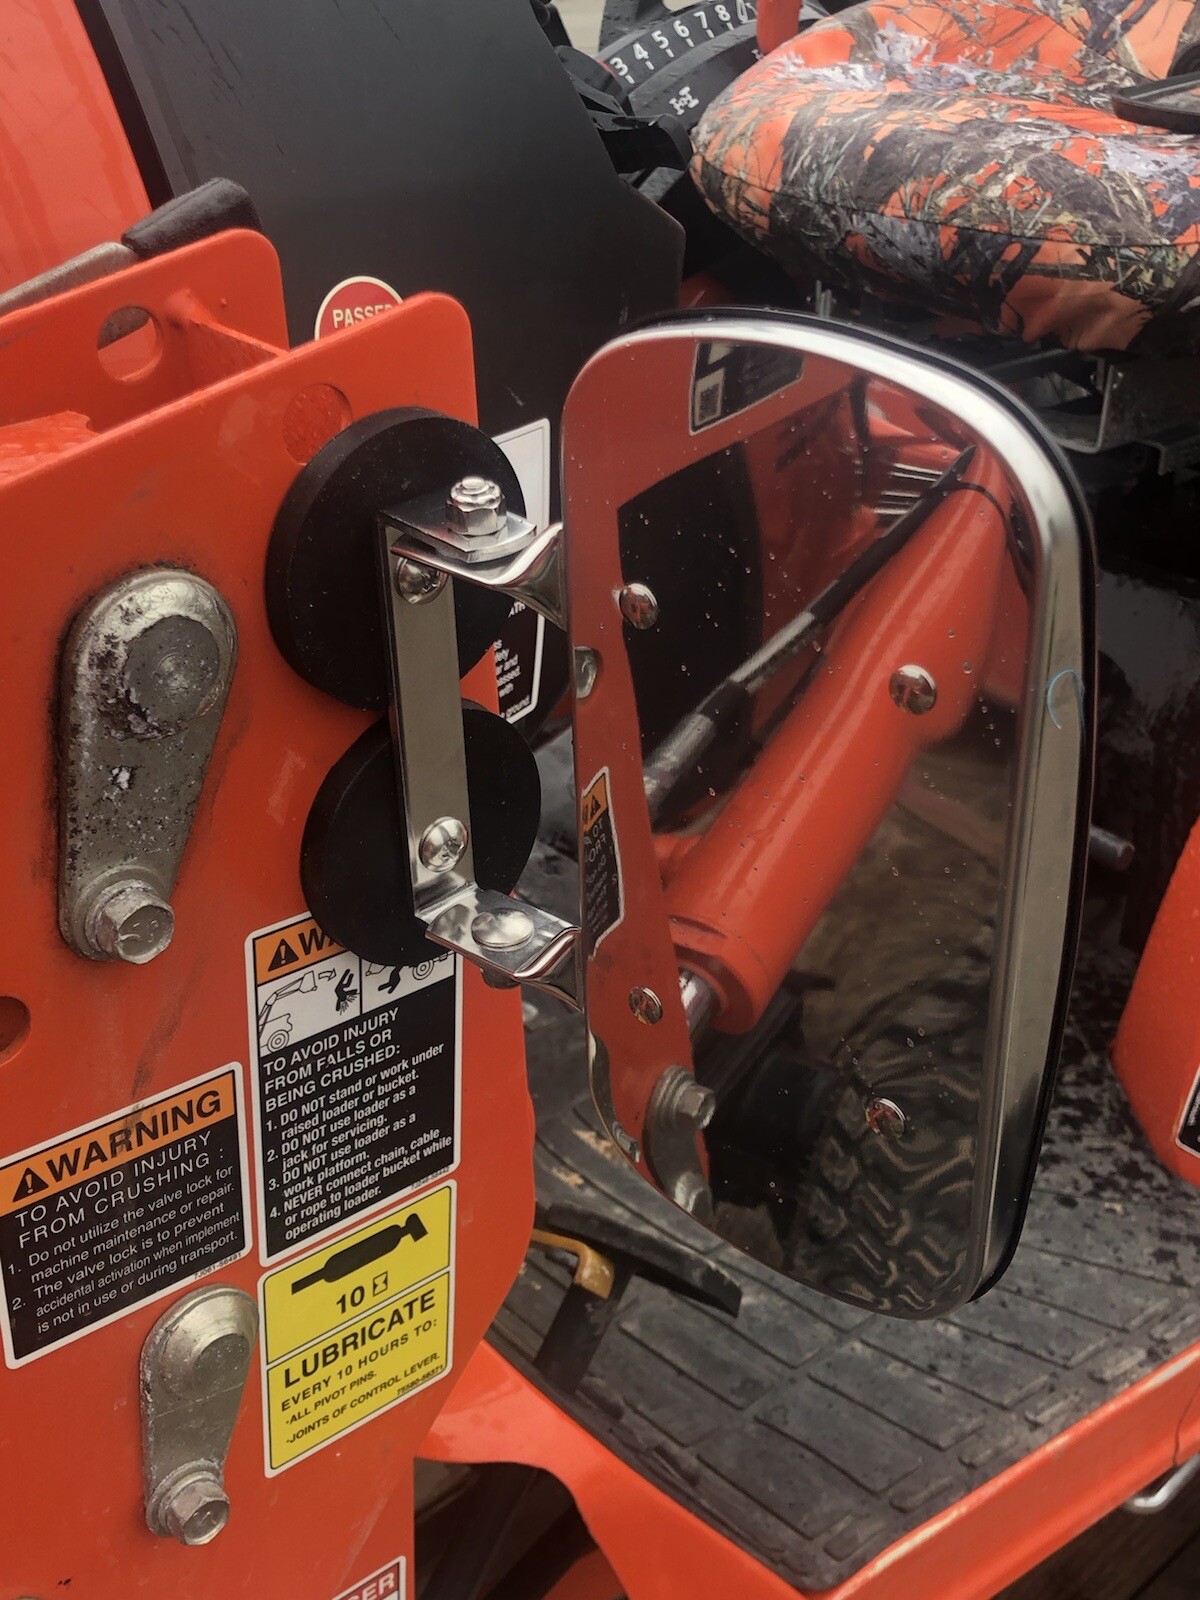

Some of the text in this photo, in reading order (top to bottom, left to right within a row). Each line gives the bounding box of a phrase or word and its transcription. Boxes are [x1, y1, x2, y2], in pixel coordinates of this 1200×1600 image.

[610, 4, 731, 77] 3 4 5 6 7 8
[263, 1007, 398, 1075] TO AVOID INJURY
[264, 1028, 392, 1095] FROM FALLS OR
[265, 1044, 400, 1113] BEING CRUSHED:
[266, 1043, 444, 1132] 1. DO NOT stand or work under
[266, 1085, 416, 1162] 2. DO NOT use loader as a
[281, 1069, 419, 1140] raised loader or bucket.
[46, 1090, 220, 1182] WARNING
[268, 1113, 416, 1191] 3. DO NOT use loader as a
[269, 1129, 440, 1218] 4. NEVER connect chain, cable
[281, 1114, 387, 1172] jack for servicing.
[283, 1151, 369, 1198] work platform.
[15, 1130, 211, 1227] TO AVOID INJURY
[284, 1136, 452, 1226] or rope to loader bucket while
[285, 1186, 381, 1240] operating loader.
[8, 1166, 233, 1275] 1. Do not utilize the valve lock for
[12, 1202, 224, 1310] 2. The valve lock is to prevent
[19, 1208, 85, 1249] FROM
[31, 1182, 234, 1283] machine maintenance or repair.
[36, 1211, 240, 1317] accidental activation when implement
[37, 1231, 238, 1333] is not in use or during transport.
[336, 1286, 365, 1315] 10
[281, 1319, 437, 1412] EVERY 10 HOURS TO:
[284, 1288, 435, 1389] LUBRICATE
[314, 1386, 347, 1410] PIVOT
[350, 1371, 376, 1390] PINS.
[332, 1404, 347, 1418] OF
[350, 1375, 401, 1408] CONTROL
[404, 1353, 439, 1377] LEVER.
